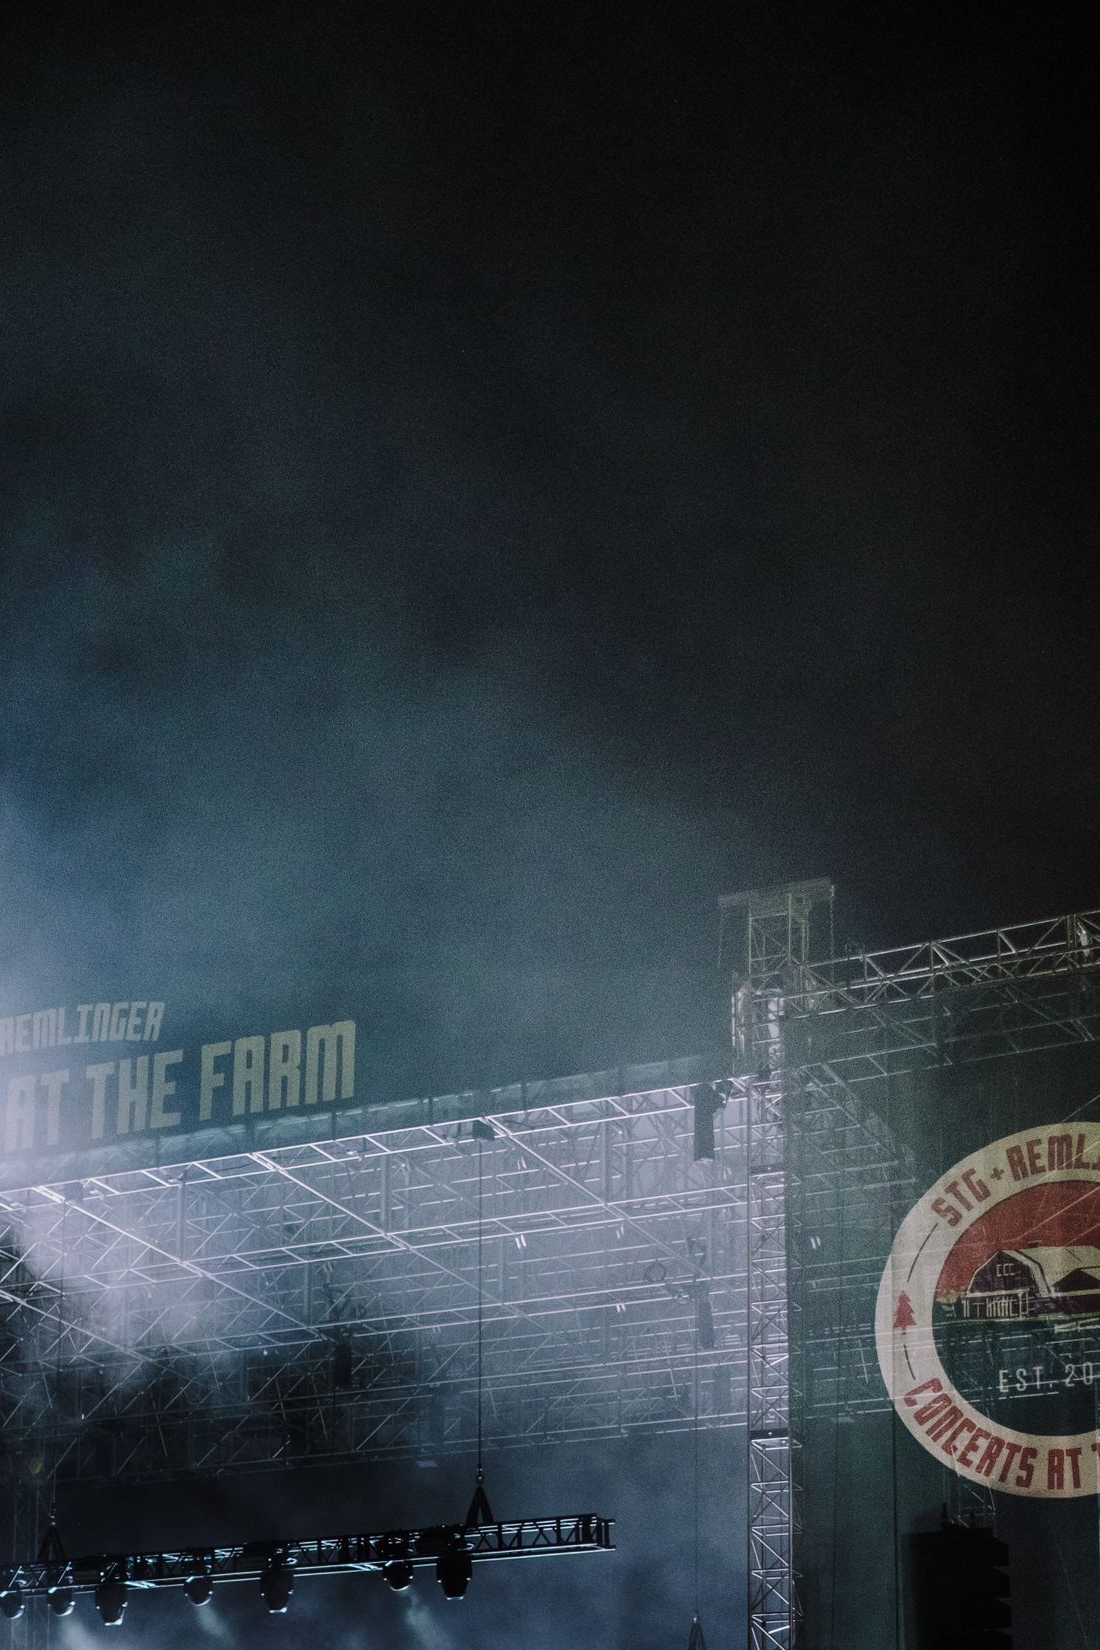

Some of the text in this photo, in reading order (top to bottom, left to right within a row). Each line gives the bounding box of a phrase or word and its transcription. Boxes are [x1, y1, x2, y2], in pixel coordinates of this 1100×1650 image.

[5, 1069, 72, 1152] AT
[85, 1050, 184, 1140] THE
[199, 1019, 357, 1122] FARM
[931, 1167, 991, 1228] STG
[999, 1366, 1054, 1393] EST.
[904, 1377, 1039, 1489] CONCERTS
[1047, 1447, 1082, 1490] AT
